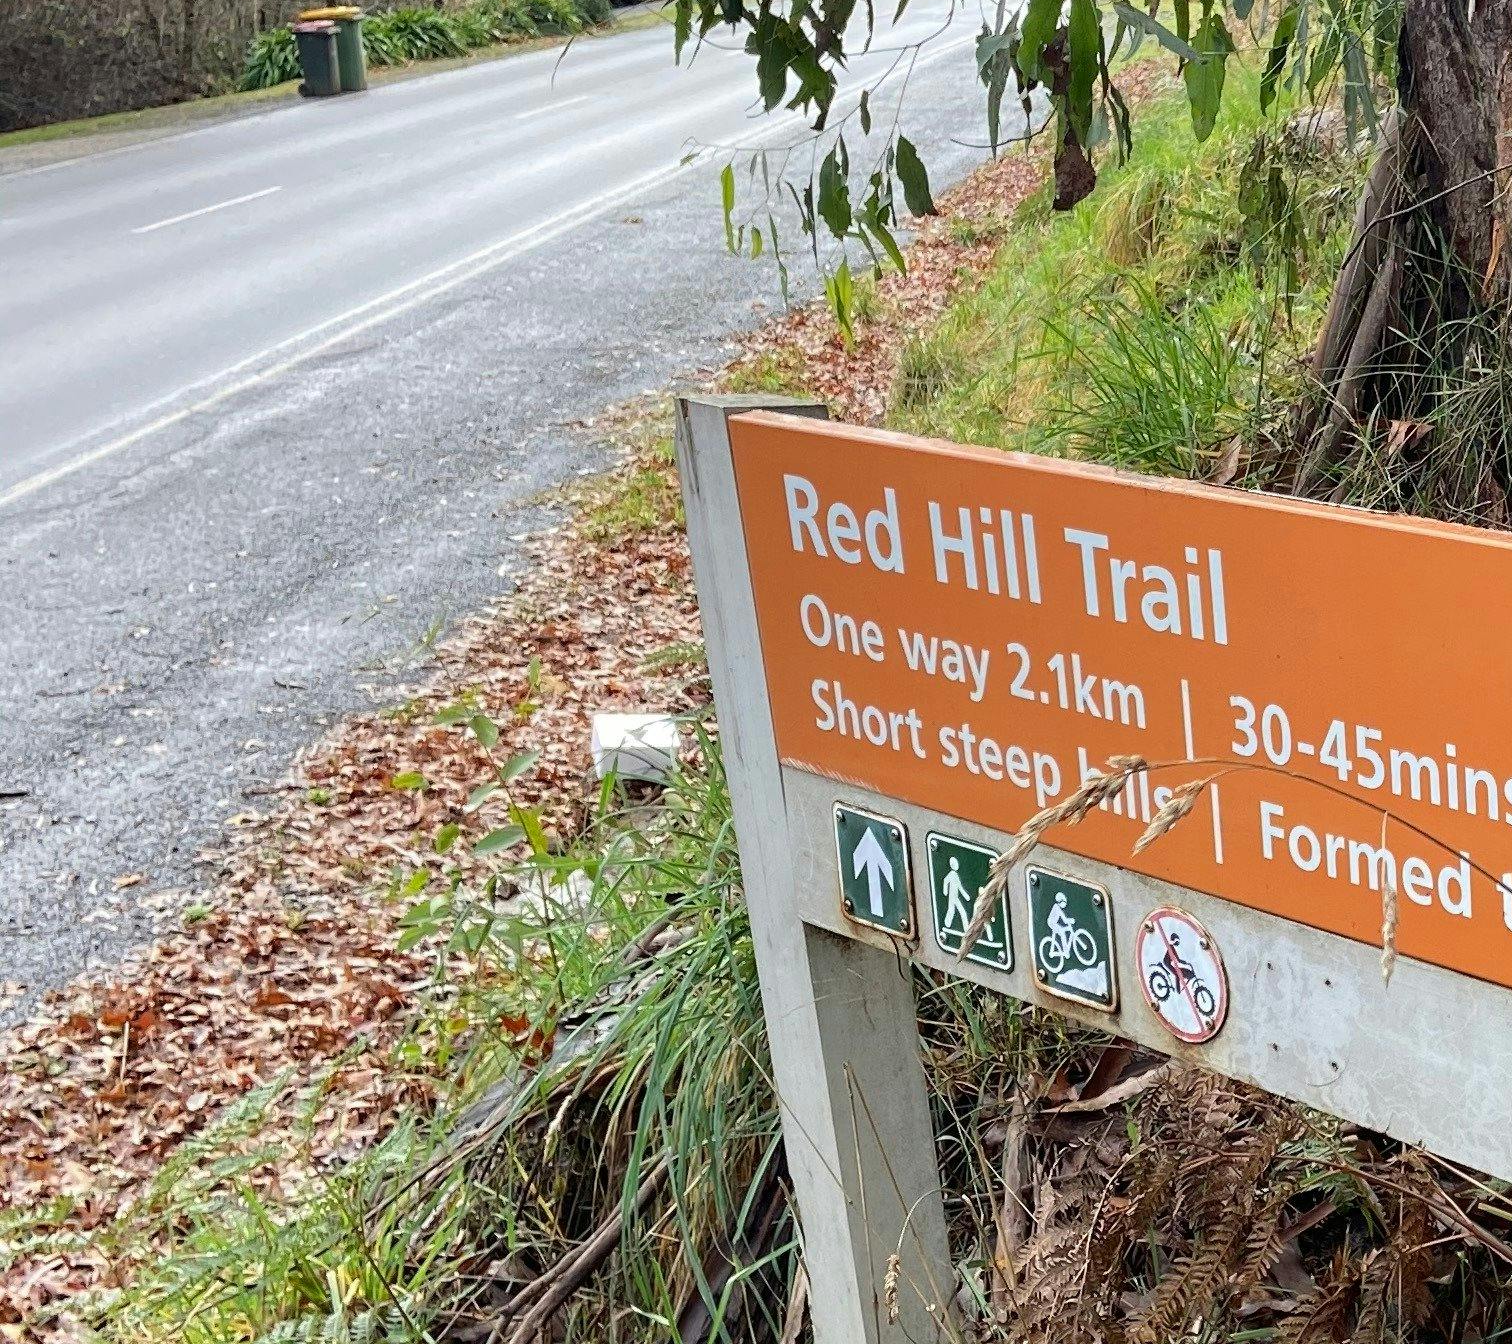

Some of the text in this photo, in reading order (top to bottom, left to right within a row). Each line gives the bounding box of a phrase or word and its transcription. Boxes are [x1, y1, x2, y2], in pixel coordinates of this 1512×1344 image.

[783, 474, 1229, 646] Red Hill Trail
[800, 594, 885, 662] One
[898, 629, 990, 703] way
[1006, 643, 1147, 730] 2.1km
[811, 678, 924, 759] Short
[939, 722, 1062, 808] steep
[1259, 800, 1473, 919] Formed
